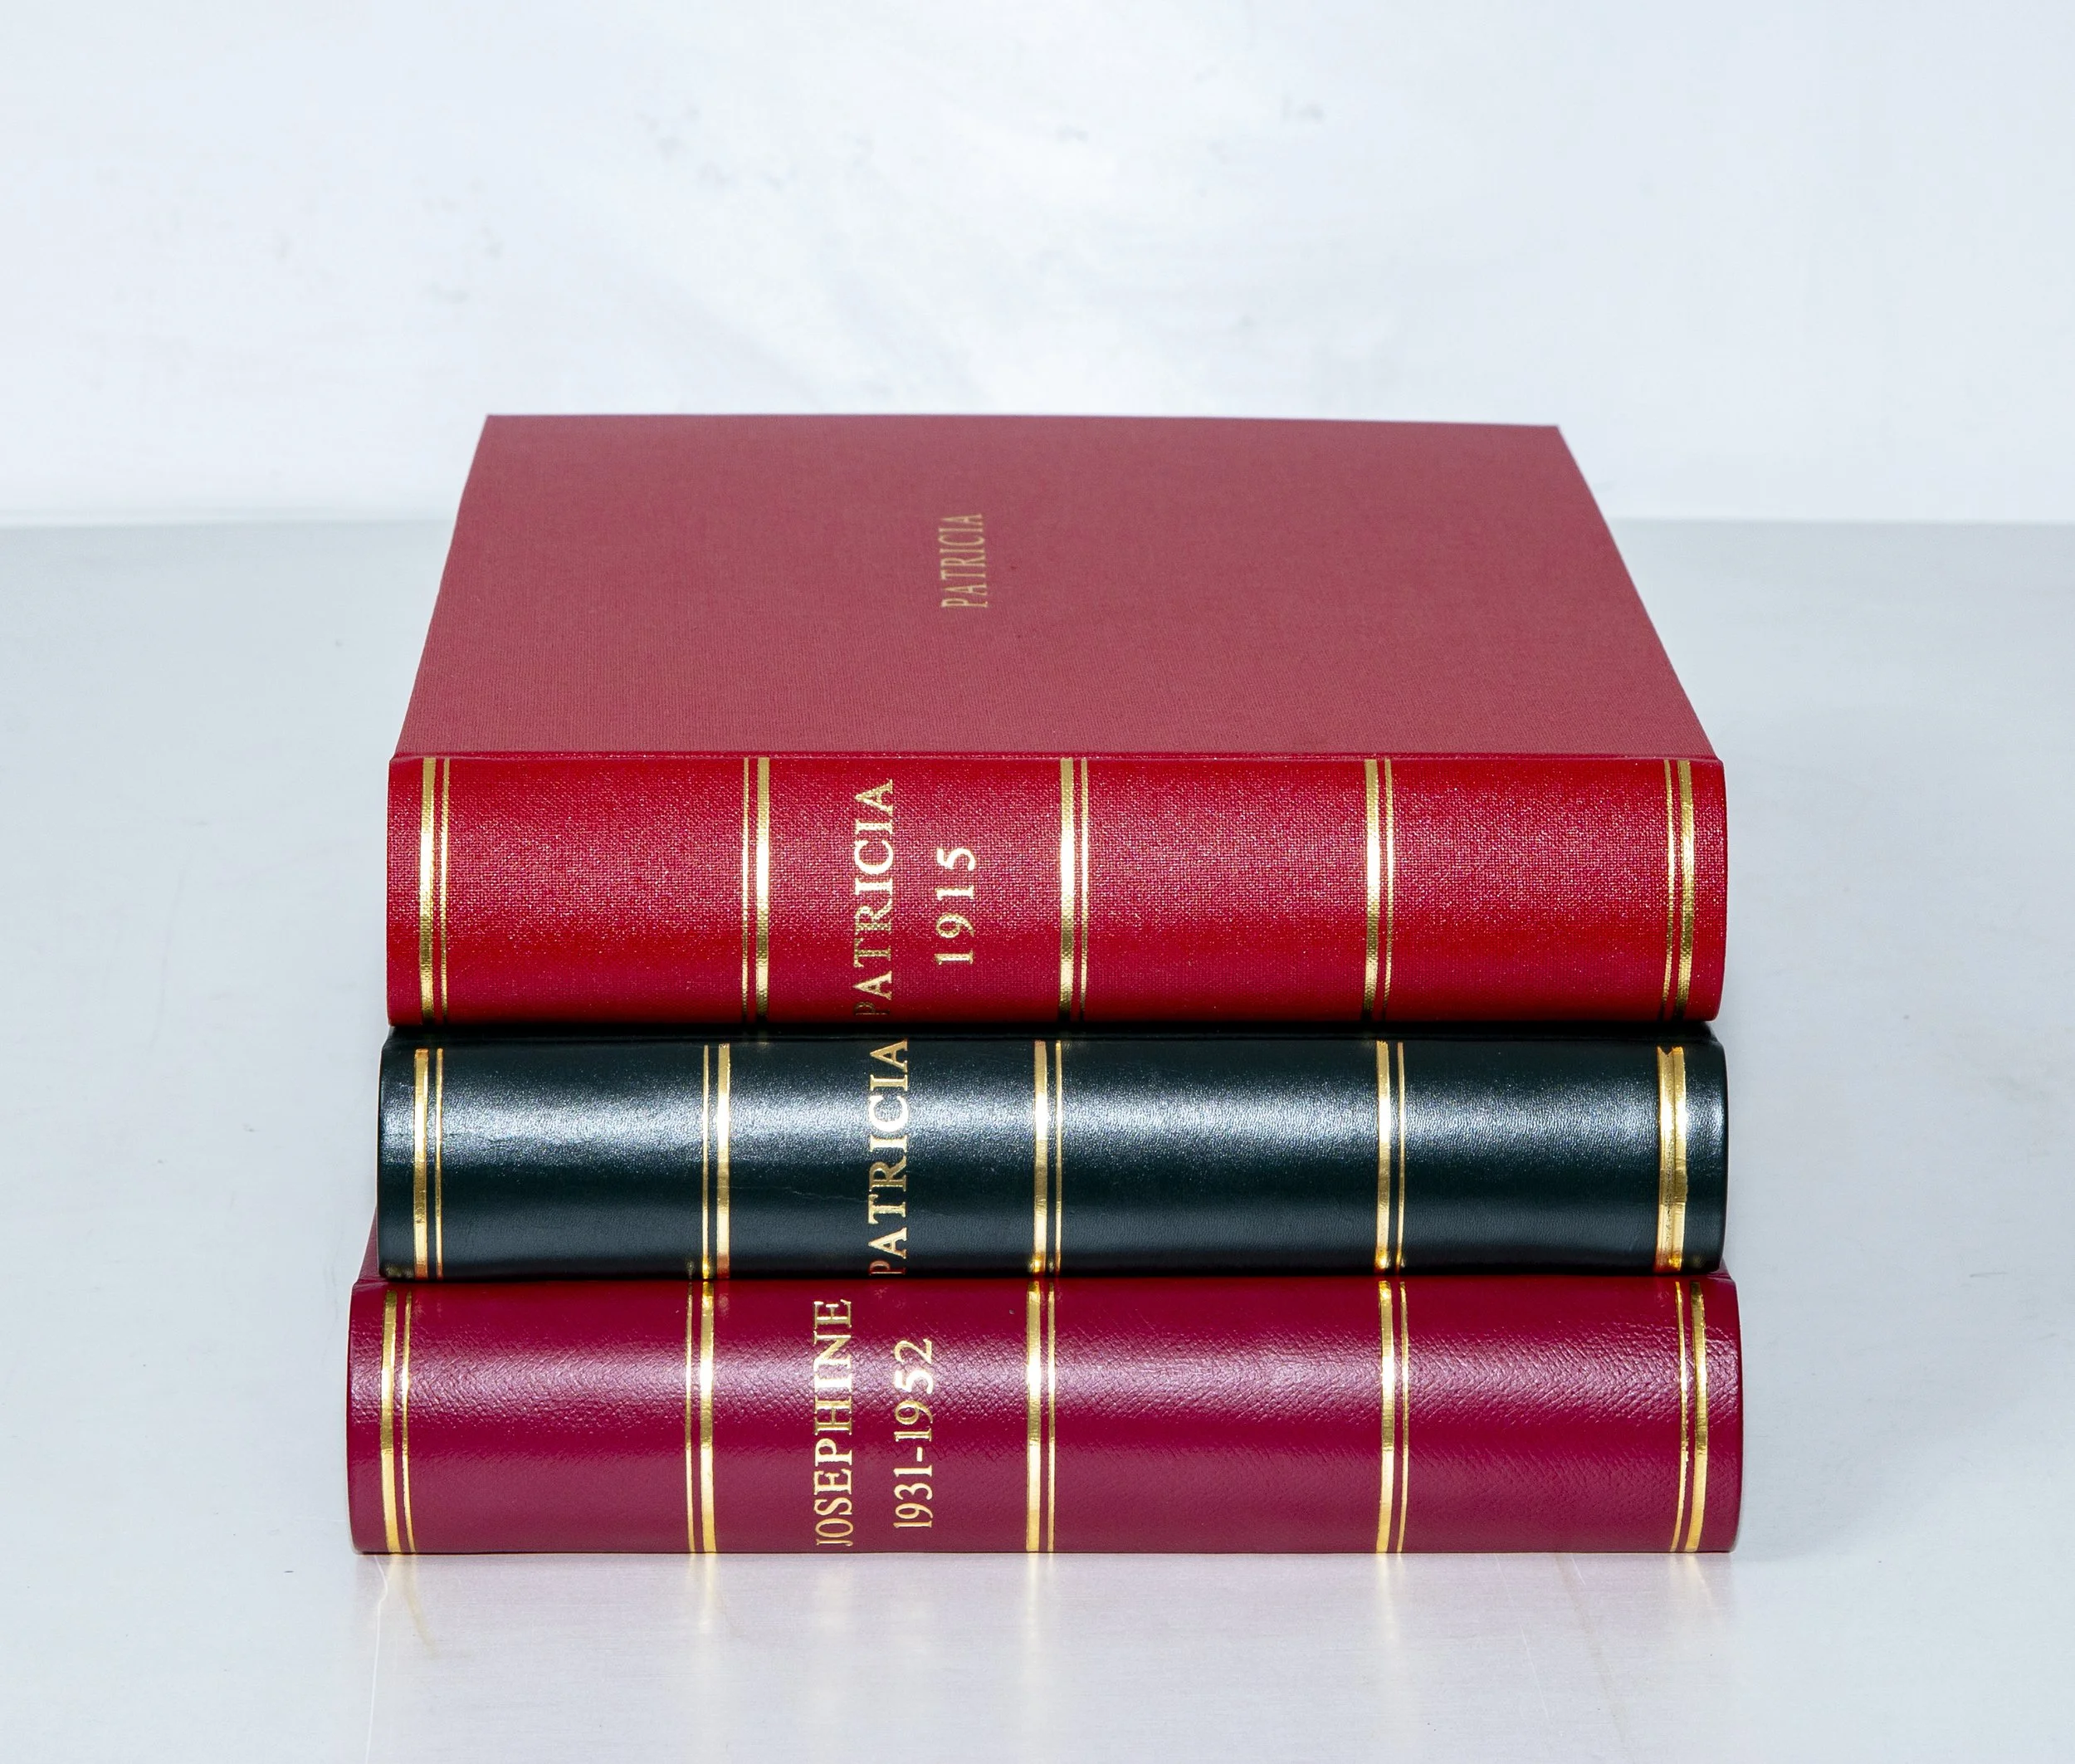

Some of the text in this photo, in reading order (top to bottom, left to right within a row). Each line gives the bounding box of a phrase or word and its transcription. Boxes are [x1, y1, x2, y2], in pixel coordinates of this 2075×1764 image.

[938, 514, 988, 608] PATRICIA
[853, 779, 893, 1015] PATRICIA
[935, 848, 975, 965] 1915
[868, 1038, 910, 1275] PATRICIA
[813, 1299, 853, 1547] JOSEPHINE
[893, 1338, 934, 1528] 1931-1952
